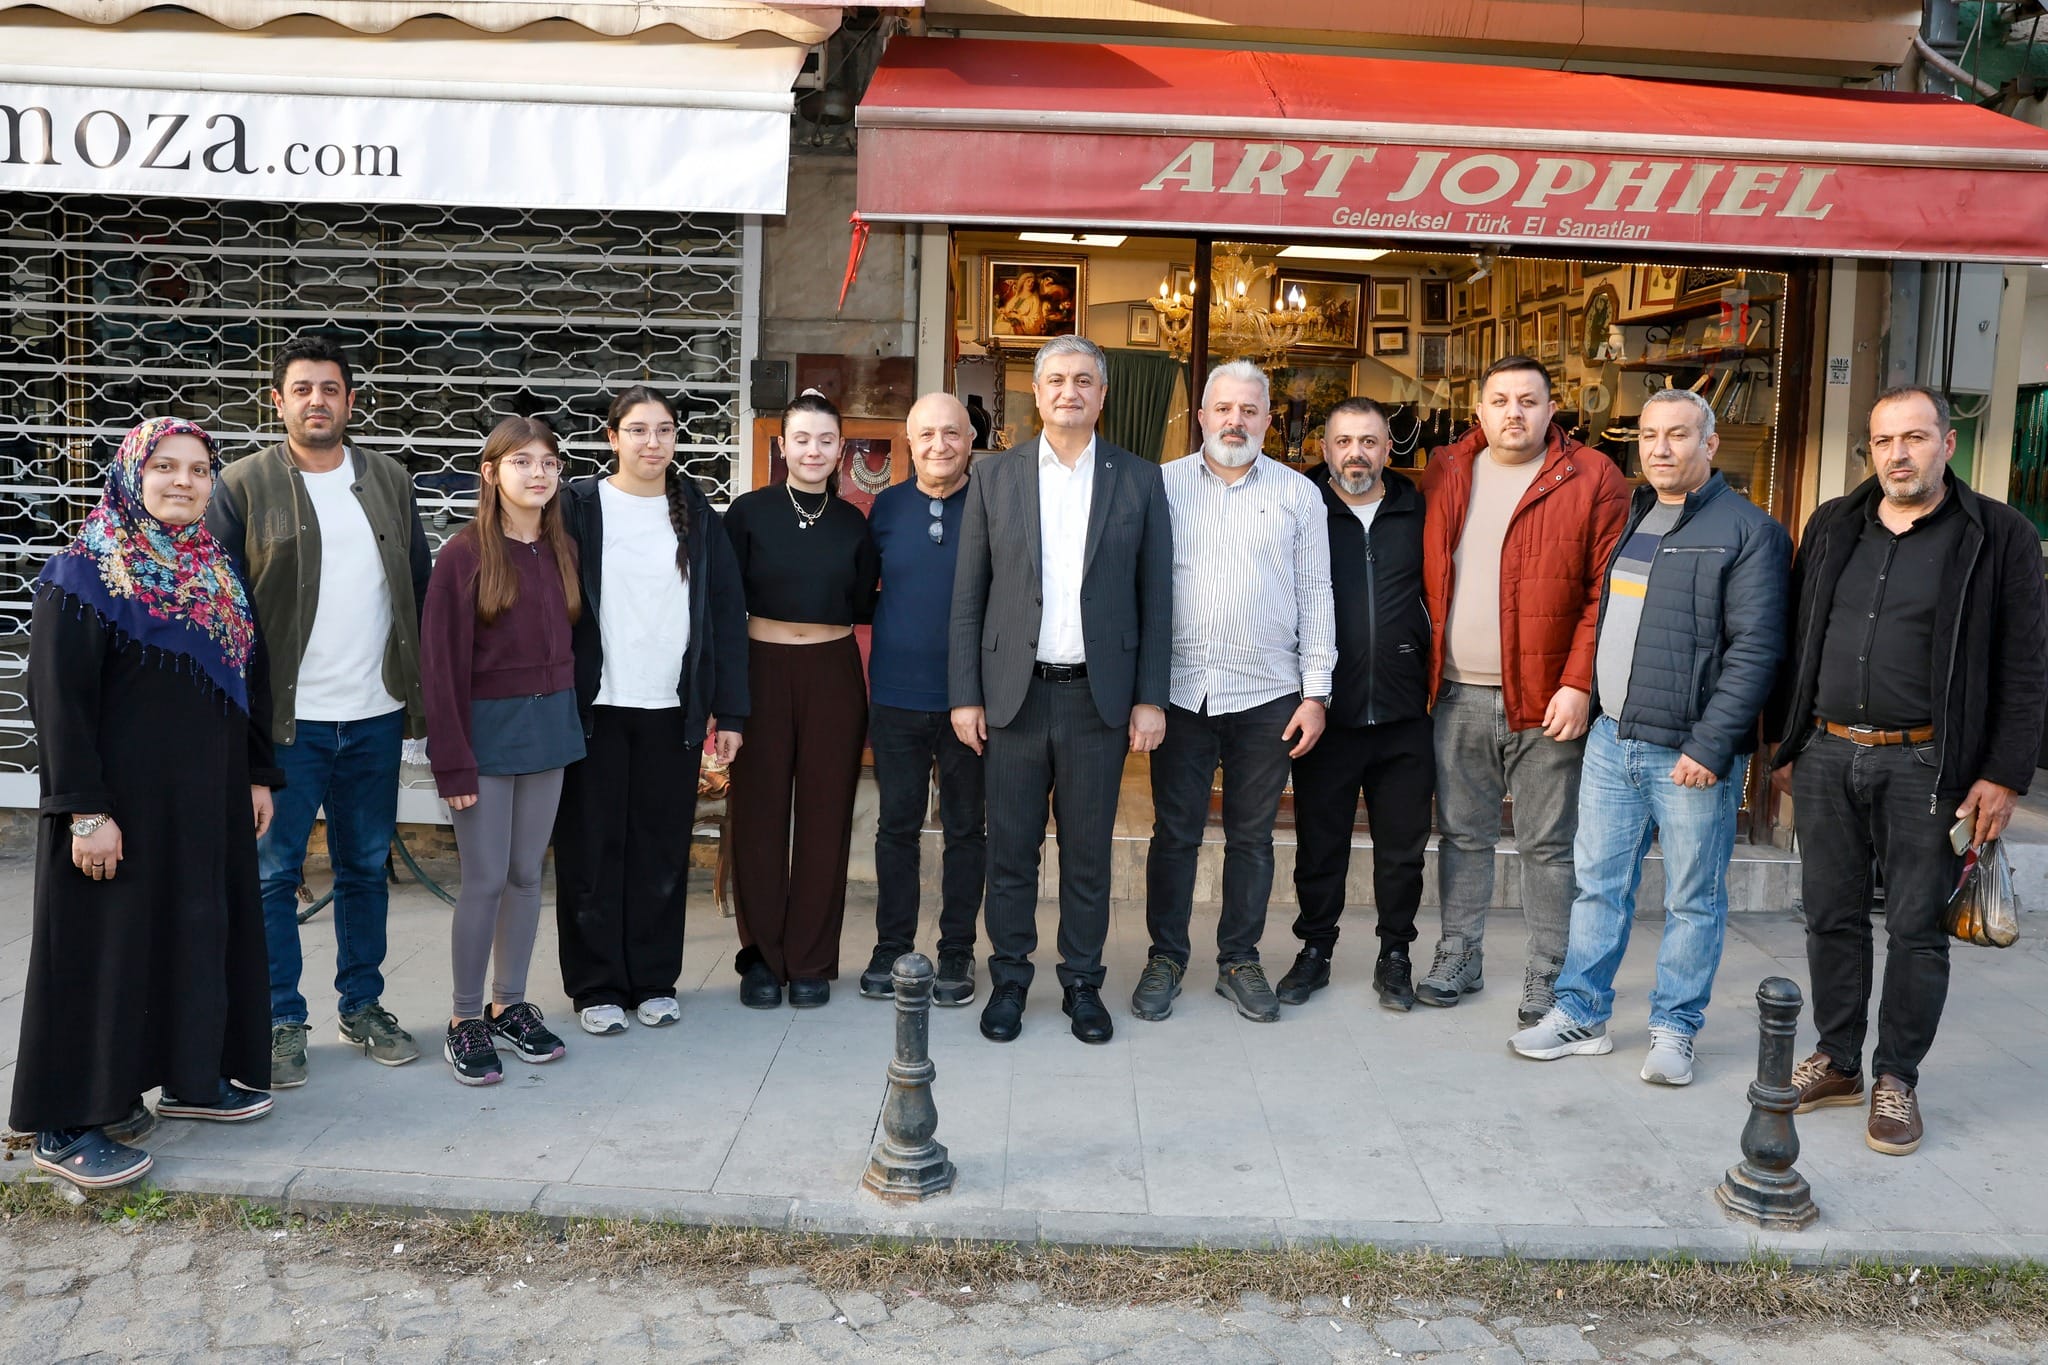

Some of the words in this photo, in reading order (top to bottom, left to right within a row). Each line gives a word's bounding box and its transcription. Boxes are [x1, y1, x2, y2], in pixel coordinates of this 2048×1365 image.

[1139, 141, 1378, 198] ART
[1386, 151, 1837, 221] JOPHIEL
[1332, 206, 1452, 231] Geleneksel
[1464, 211, 1512, 234] Türk
[1522, 216, 1545, 235] El
[1556, 217, 1650, 240] Sanatları
